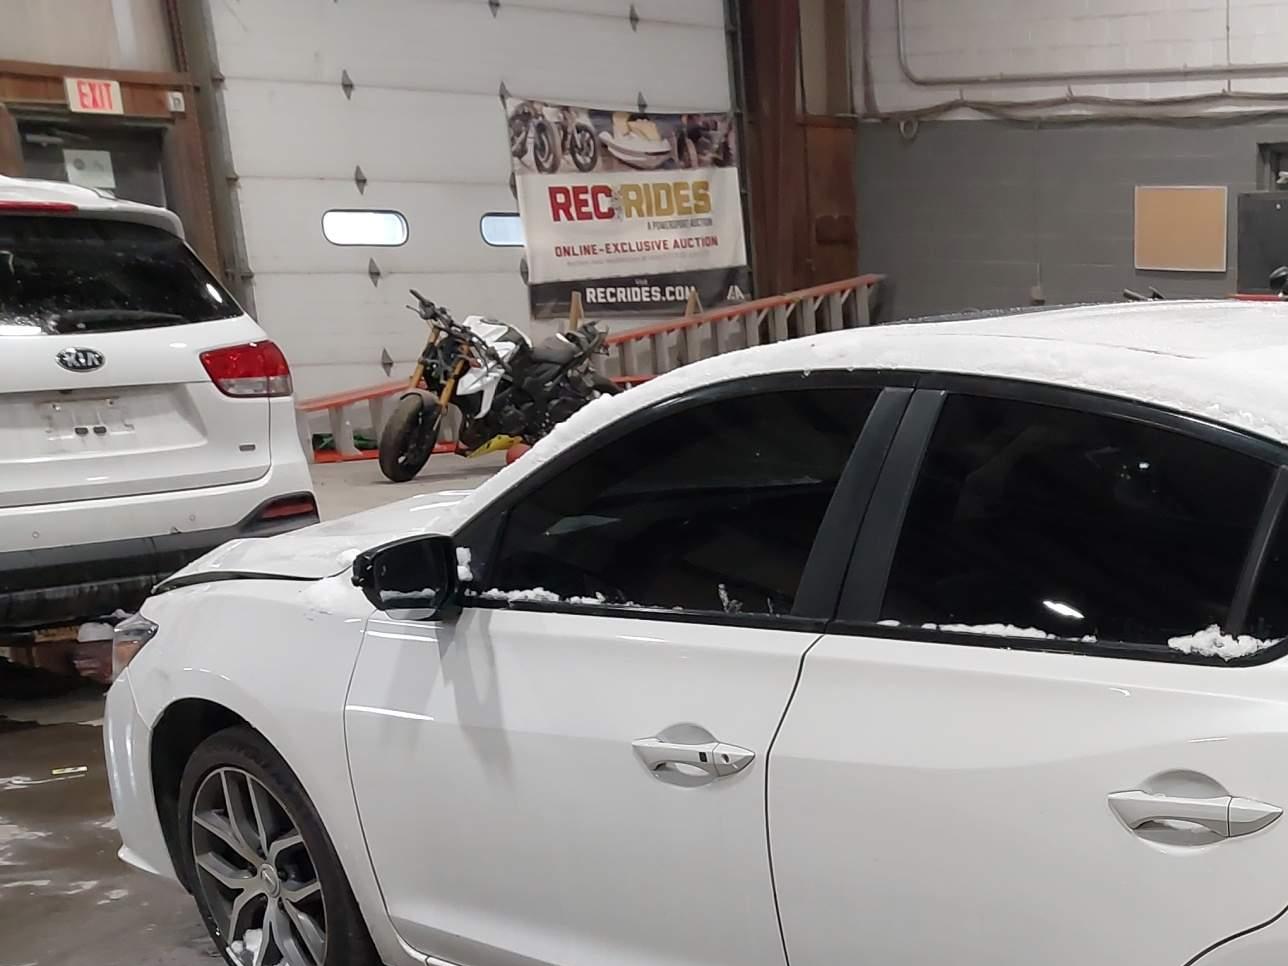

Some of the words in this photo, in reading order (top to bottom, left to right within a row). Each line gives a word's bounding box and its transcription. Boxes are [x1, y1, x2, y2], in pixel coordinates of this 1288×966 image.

[77, 80, 113, 110] EXIT
[548, 185, 616, 222] REC
[620, 180, 712, 218] RIDES
[555, 239, 669, 258] ONLINE-EXCLUSIVE
[673, 236, 719, 250] AUCTION
